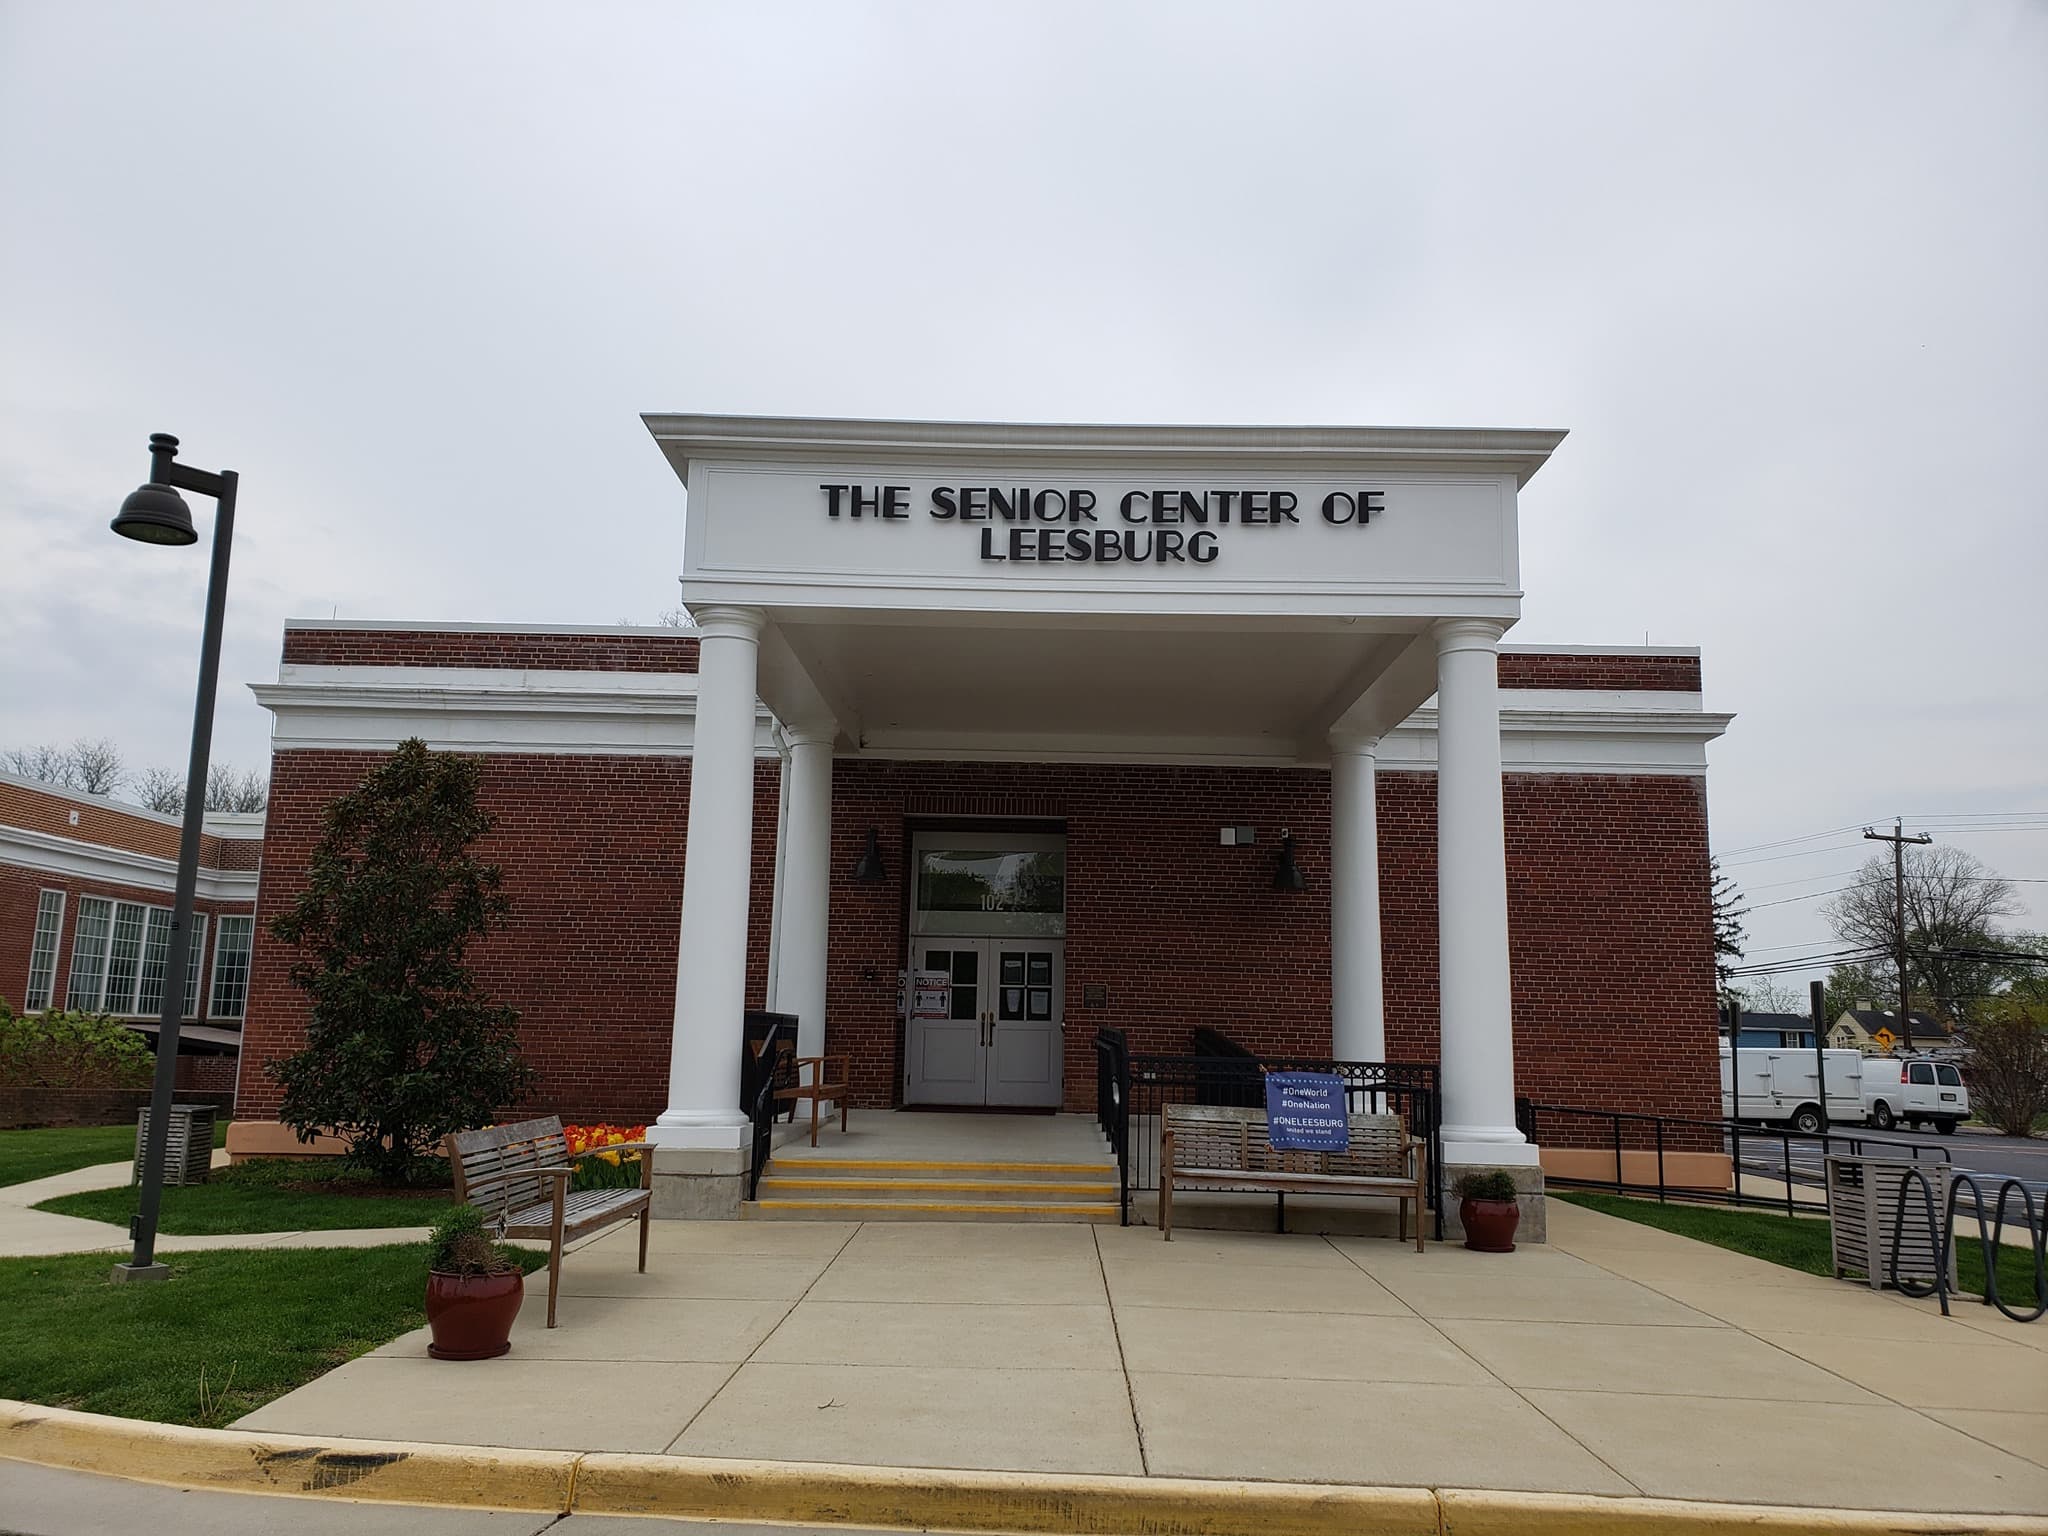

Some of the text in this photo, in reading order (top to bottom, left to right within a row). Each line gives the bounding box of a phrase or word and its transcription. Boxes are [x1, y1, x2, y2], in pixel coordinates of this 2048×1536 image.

[820, 485, 1384, 524] THE SENIOR CENTER OF
[981, 528, 1218, 562] LEESBURG
[980, 894, 1004, 911] 102
[916, 978, 948, 987] NOTICE
[1282, 1087, 1327, 1096] #OneWorld
[1282, 1100, 1330, 1109] #OneNation
[1273, 1116, 1343, 1127] #ONELEESBURG
